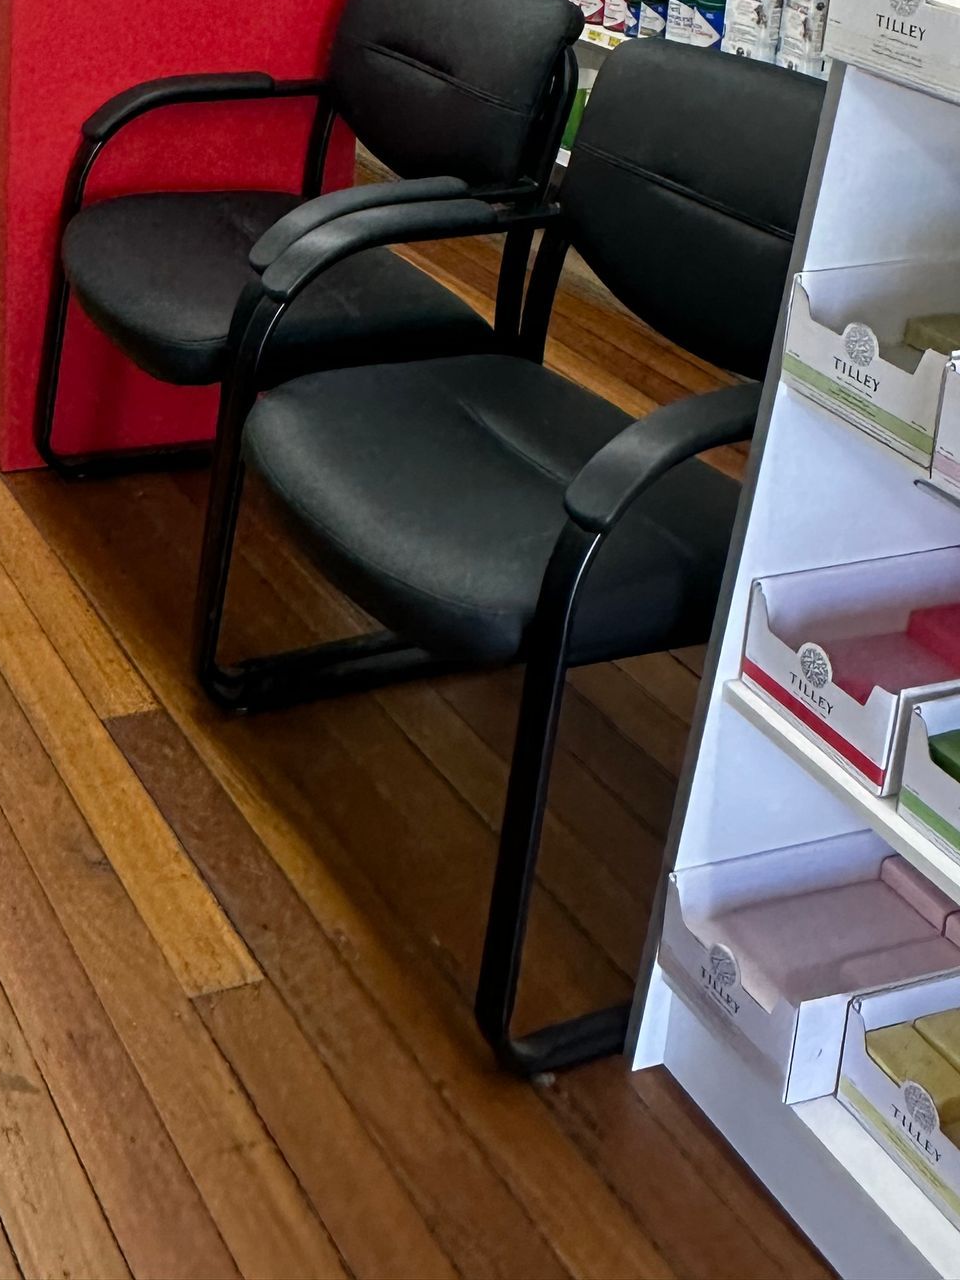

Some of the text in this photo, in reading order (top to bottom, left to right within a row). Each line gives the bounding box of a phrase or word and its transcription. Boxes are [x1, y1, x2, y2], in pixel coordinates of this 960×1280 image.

[876, 13, 926, 41] TILLEY
[833, 356, 880, 392] TILLEY
[789, 672, 833, 715] TILLEY
[701, 966, 740, 1013] TILLEY
[889, 1104, 941, 1162] TILLEY
